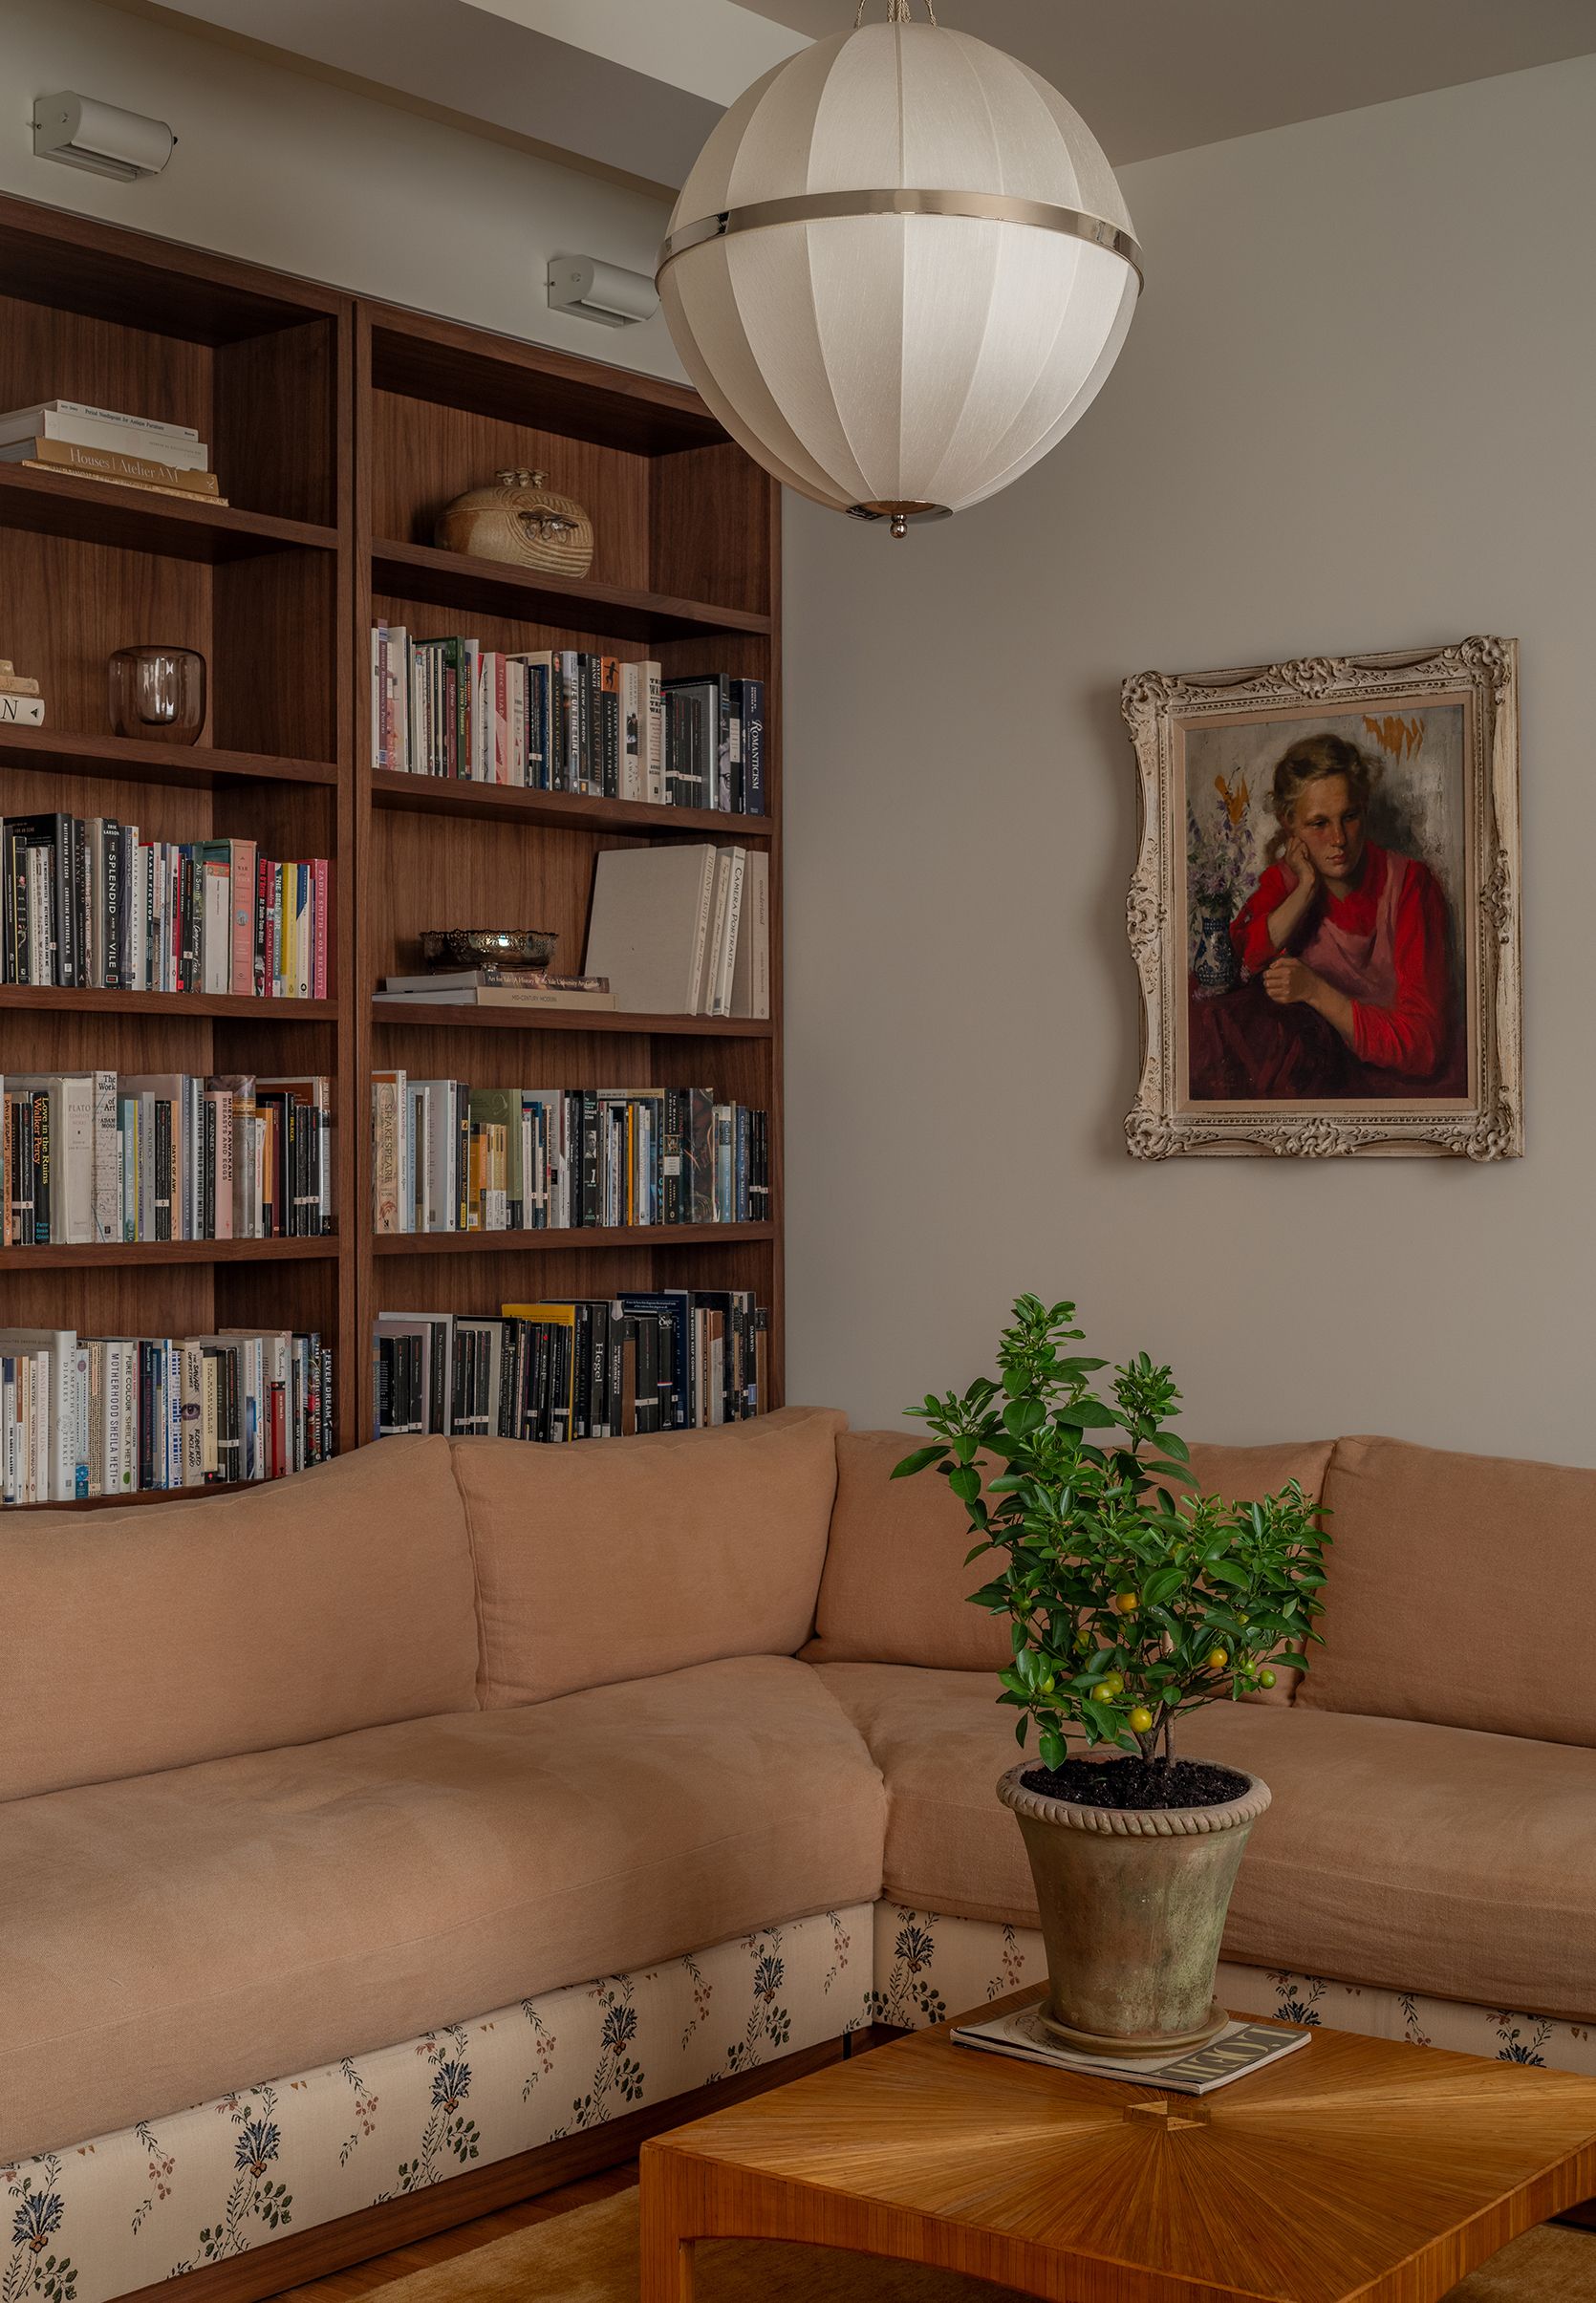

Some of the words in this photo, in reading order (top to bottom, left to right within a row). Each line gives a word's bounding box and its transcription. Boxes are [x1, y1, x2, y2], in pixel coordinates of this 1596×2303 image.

[70, 447, 110, 469] Houses
[120, 459, 155, 478] Atelier
[572, 699, 577, 712] ON
[750, 720, 763, 789] ROMANTICISM
[108, 853, 119, 914] SPLENDID
[732, 867, 743, 910] CAMERA
[108, 943, 118, 968] VILE
[318, 939, 323, 954] ON
[727, 914, 738, 968] PORTRAITS
[33, 1098, 42, 1133] Walker
[42, 1125, 49, 1133] in
[32, 1137, 42, 1164] Percy
[383, 1104, 393, 1184] SHAKESPEARE
[593, 1343, 603, 1383] Hegel
[110, 1353, 119, 1417] MOTHERHOOD
[109, 1420, 119, 1453] SHEILA
